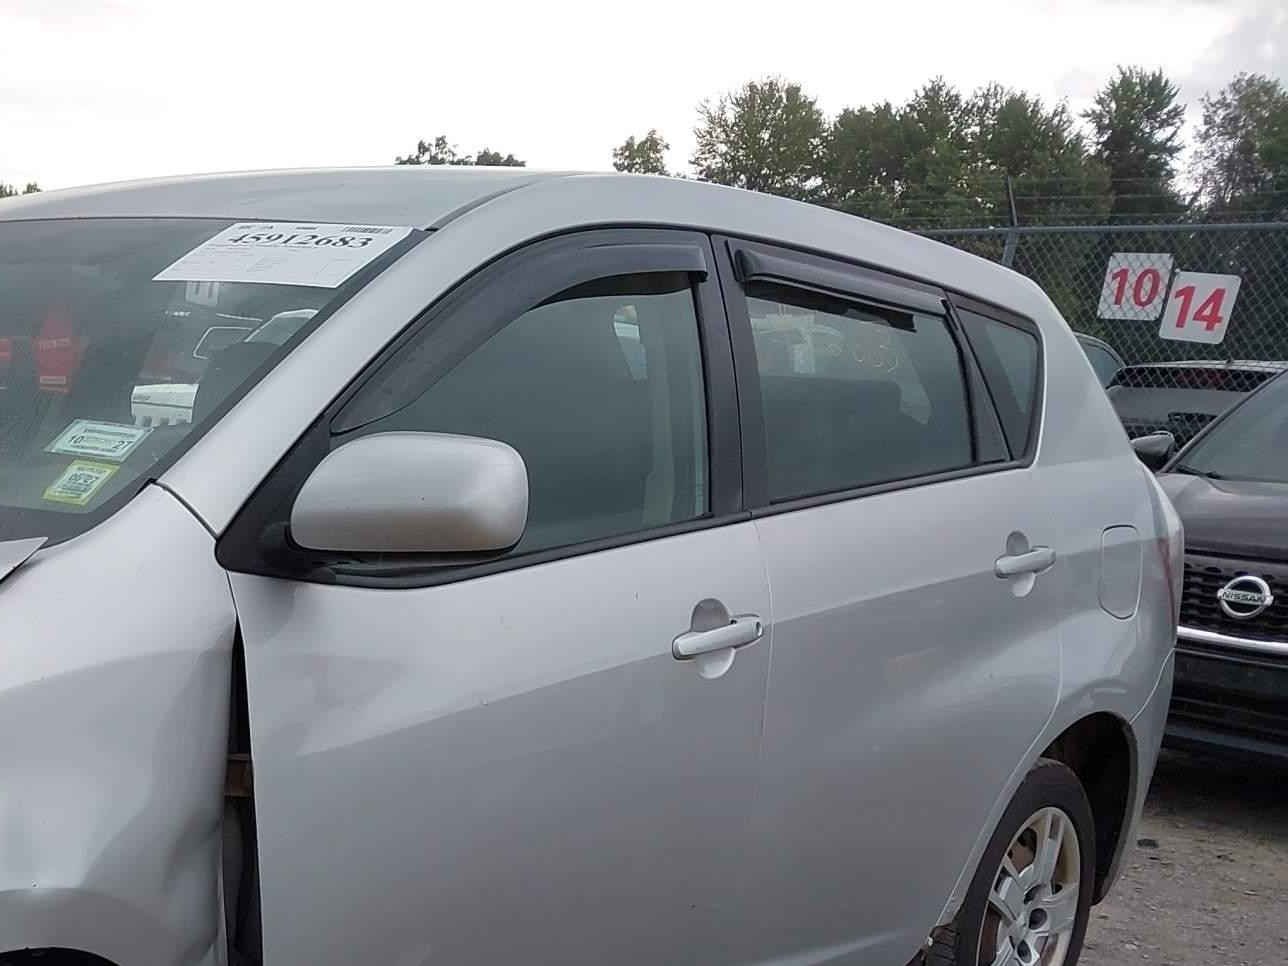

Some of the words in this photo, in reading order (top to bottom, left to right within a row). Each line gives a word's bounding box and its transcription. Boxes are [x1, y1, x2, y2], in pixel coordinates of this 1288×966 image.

[228, 233, 374, 249] 45912683
[1112, 268, 1160, 309] 10
[1174, 285, 1226, 331] 14
[68, 435, 85, 444] 10
[112, 440, 133, 450] 27
[1222, 591, 1266, 604] NISSAN
